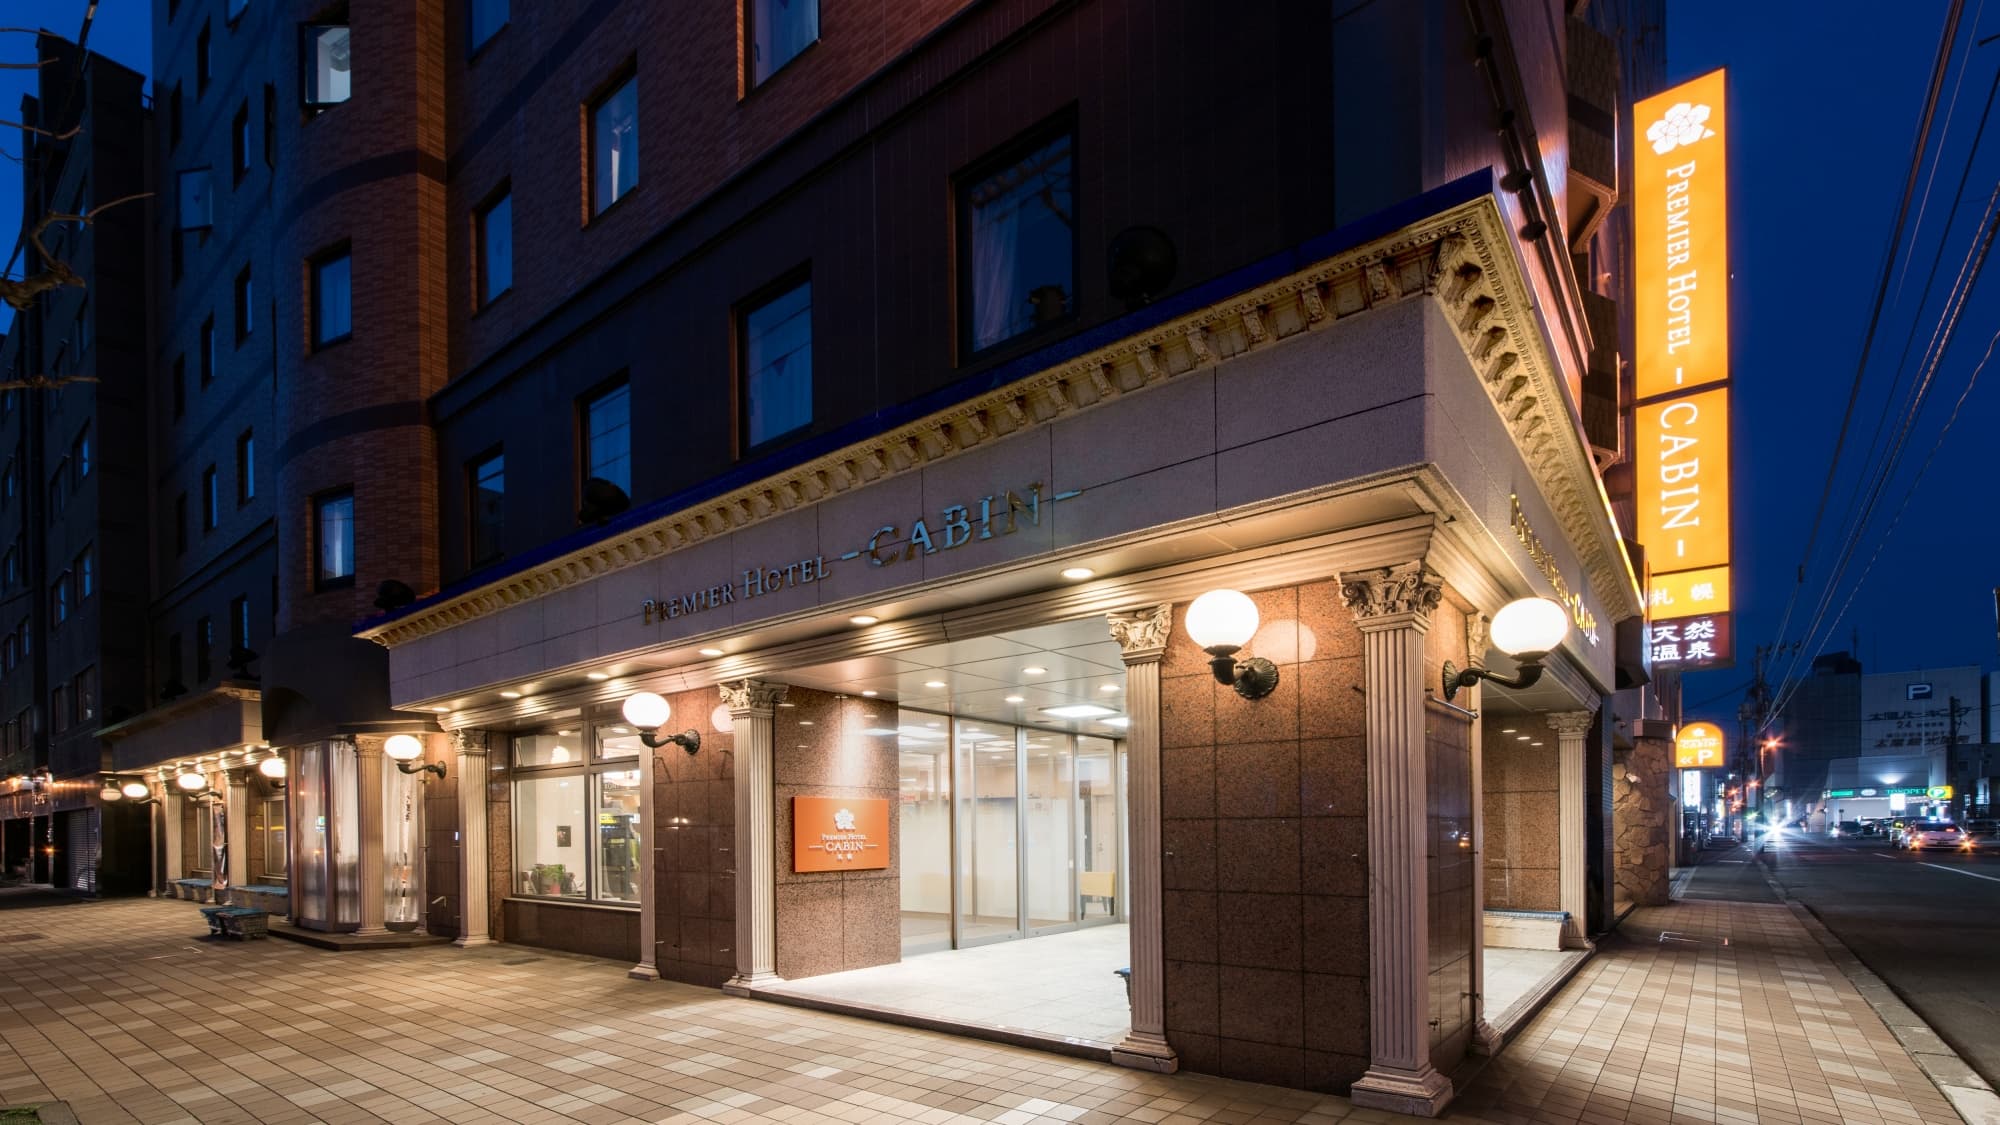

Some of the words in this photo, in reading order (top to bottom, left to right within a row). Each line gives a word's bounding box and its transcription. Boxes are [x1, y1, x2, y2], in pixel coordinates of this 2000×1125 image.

[1667, 159, 1695, 270] PREMIER
[1667, 269, 1697, 355] HOTEL
[642, 583, 736, 625] PREMIER
[742, 555, 832, 599] HOTEL
[868, 481, 1044, 568] CABIN
[1908, 684, 1931, 700] P
[1698, 749, 1713, 764] P
[825, 841, 863, 852] CABIN
